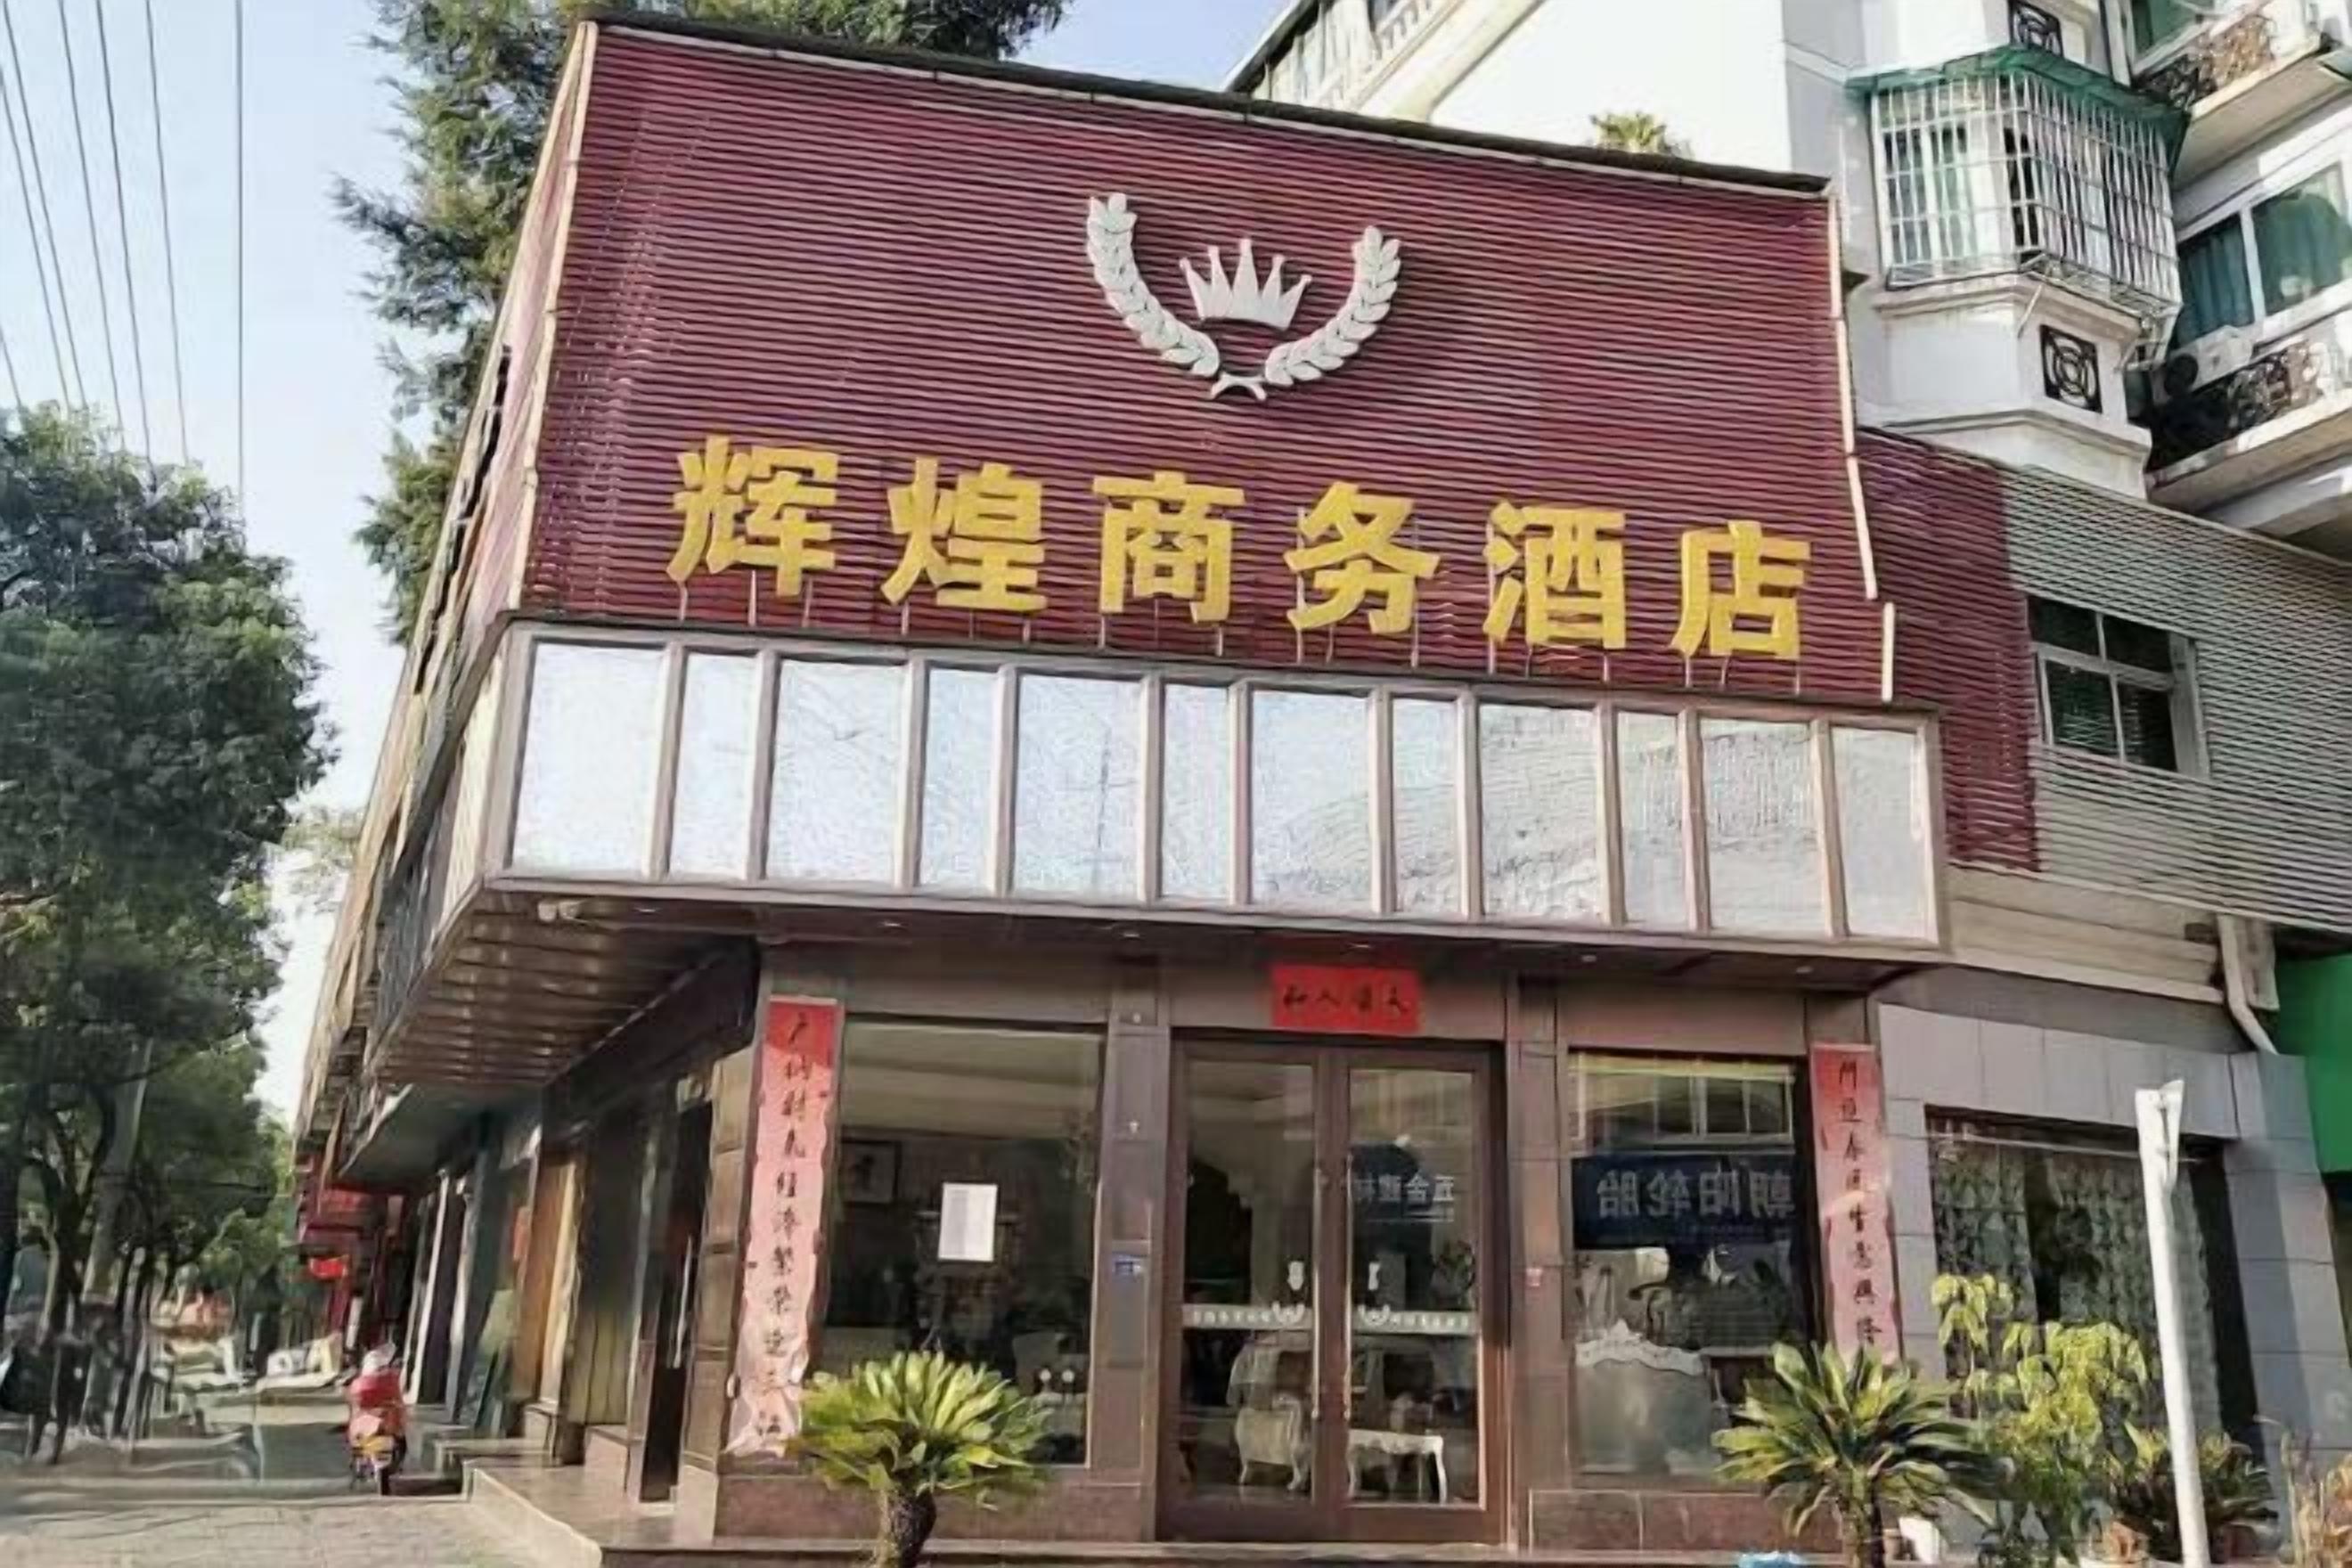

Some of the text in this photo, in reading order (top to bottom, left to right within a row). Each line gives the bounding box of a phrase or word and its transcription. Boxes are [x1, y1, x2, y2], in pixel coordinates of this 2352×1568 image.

[666, 435, 1812, 661] 辉煌商务酒店
